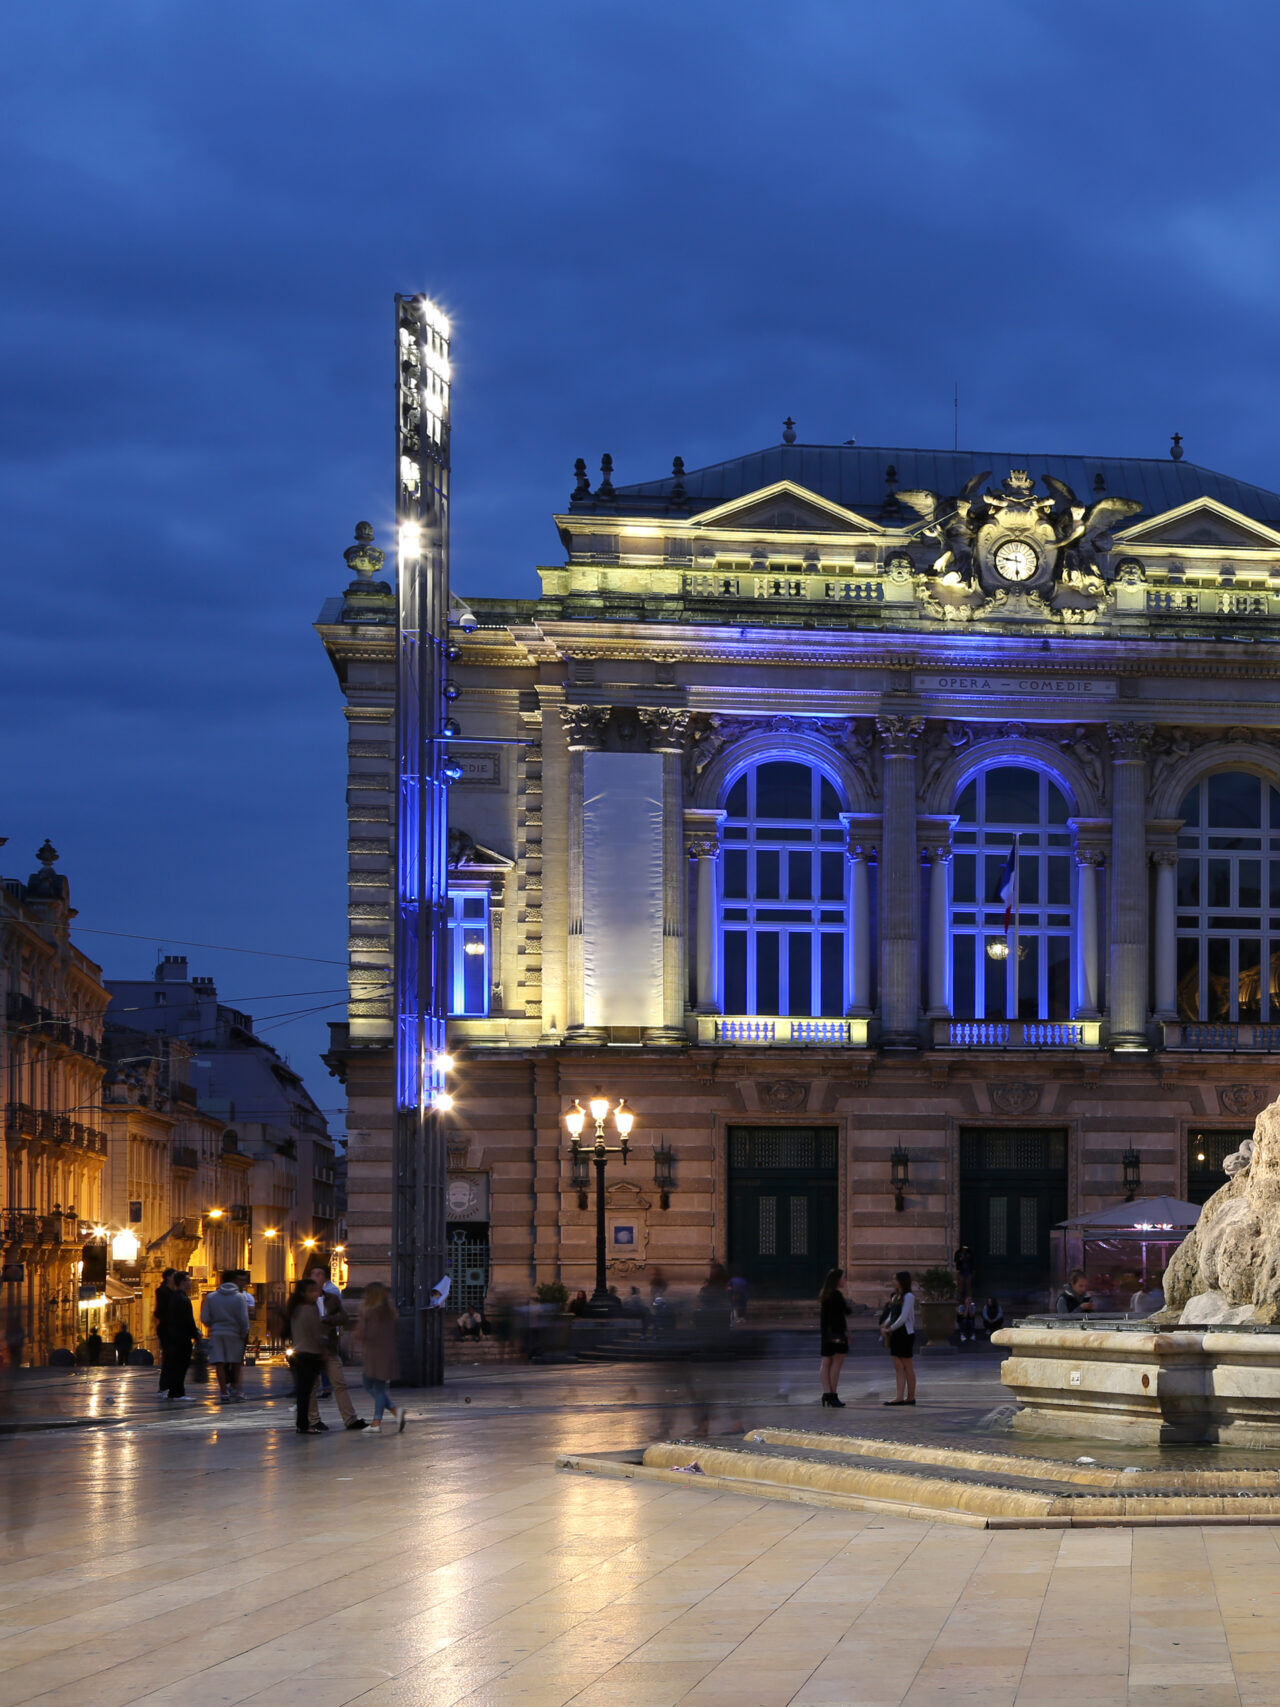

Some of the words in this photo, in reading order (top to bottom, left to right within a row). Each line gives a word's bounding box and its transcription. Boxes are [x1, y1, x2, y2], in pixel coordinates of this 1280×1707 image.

[939, 678, 991, 689] OPERA
[1018, 680, 1093, 692] COMEDIE
[460, 763, 488, 773] EDIE
